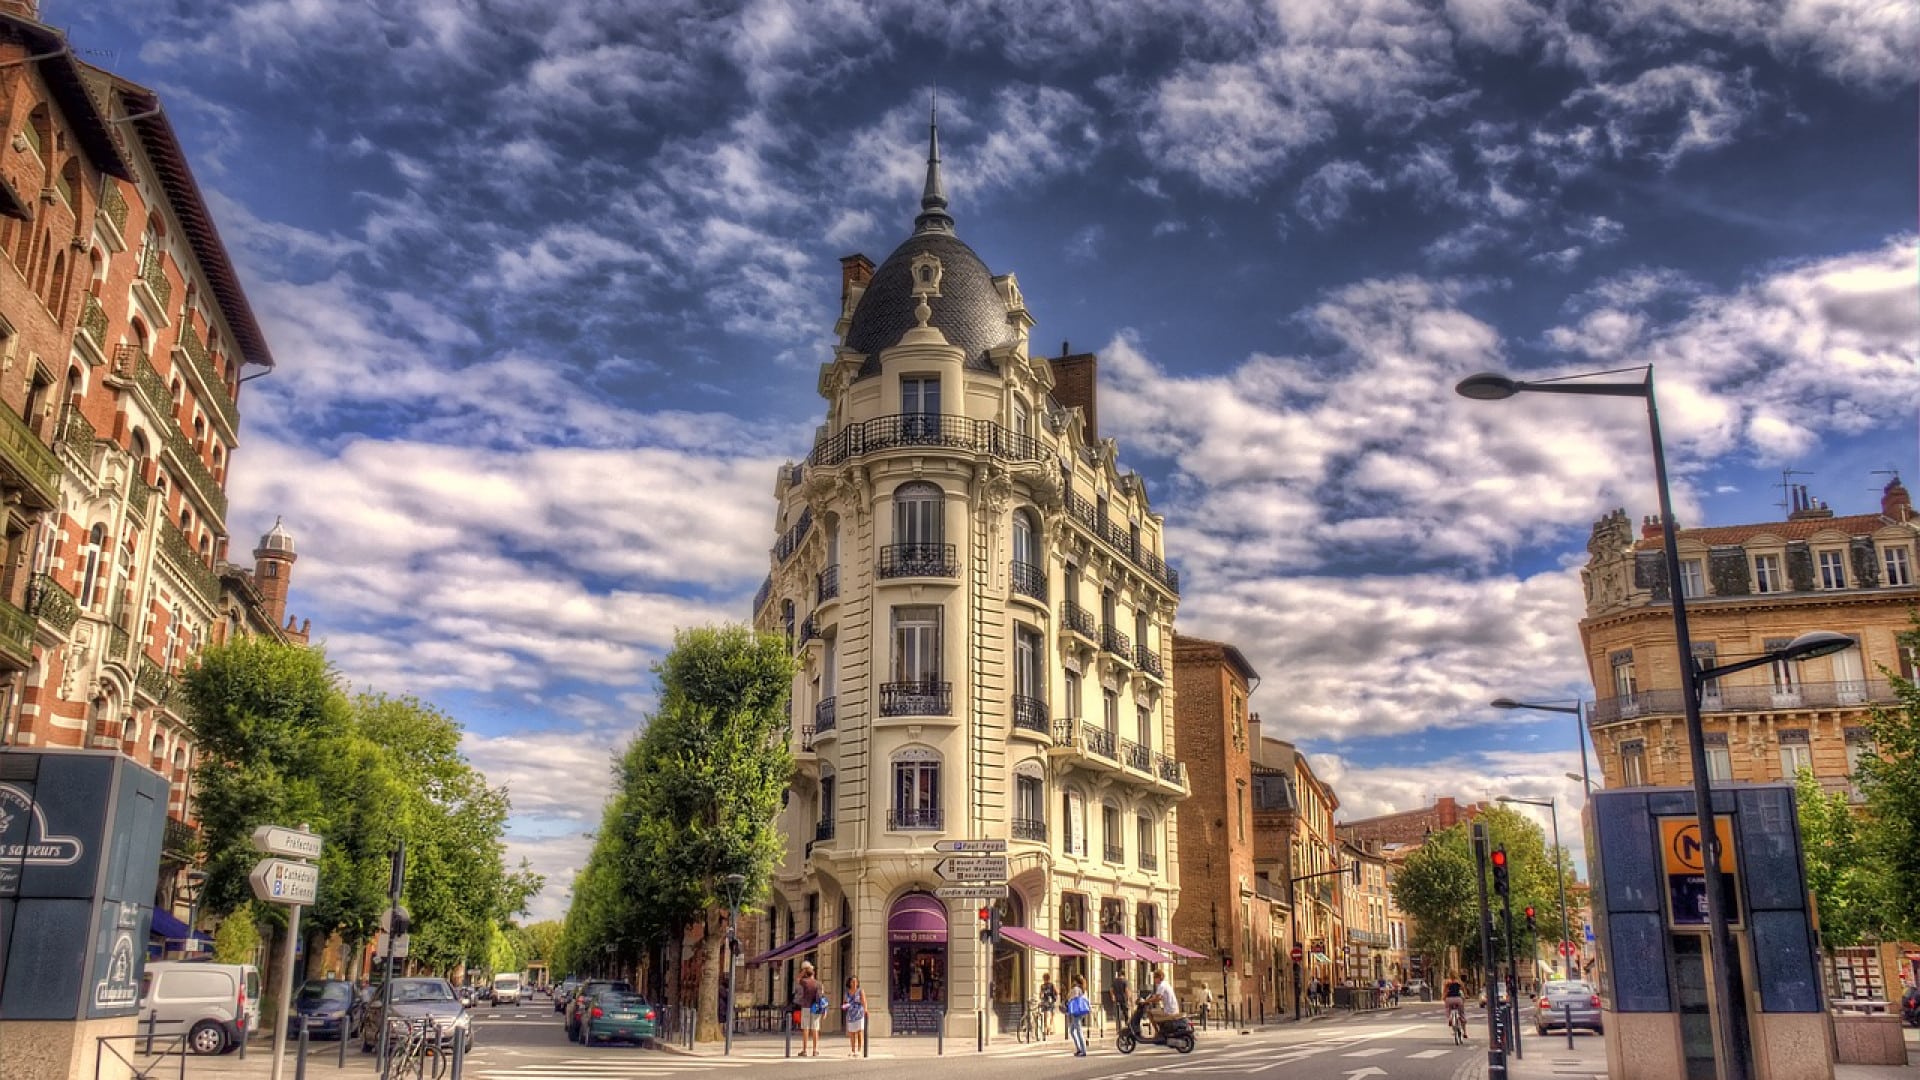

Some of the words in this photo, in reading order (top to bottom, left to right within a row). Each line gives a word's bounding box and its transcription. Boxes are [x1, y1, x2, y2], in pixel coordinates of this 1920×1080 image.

[286, 835, 319, 851] Préfecture
[284, 868, 316, 883] Cathédrale
[940, 889, 961, 897] Jardin
